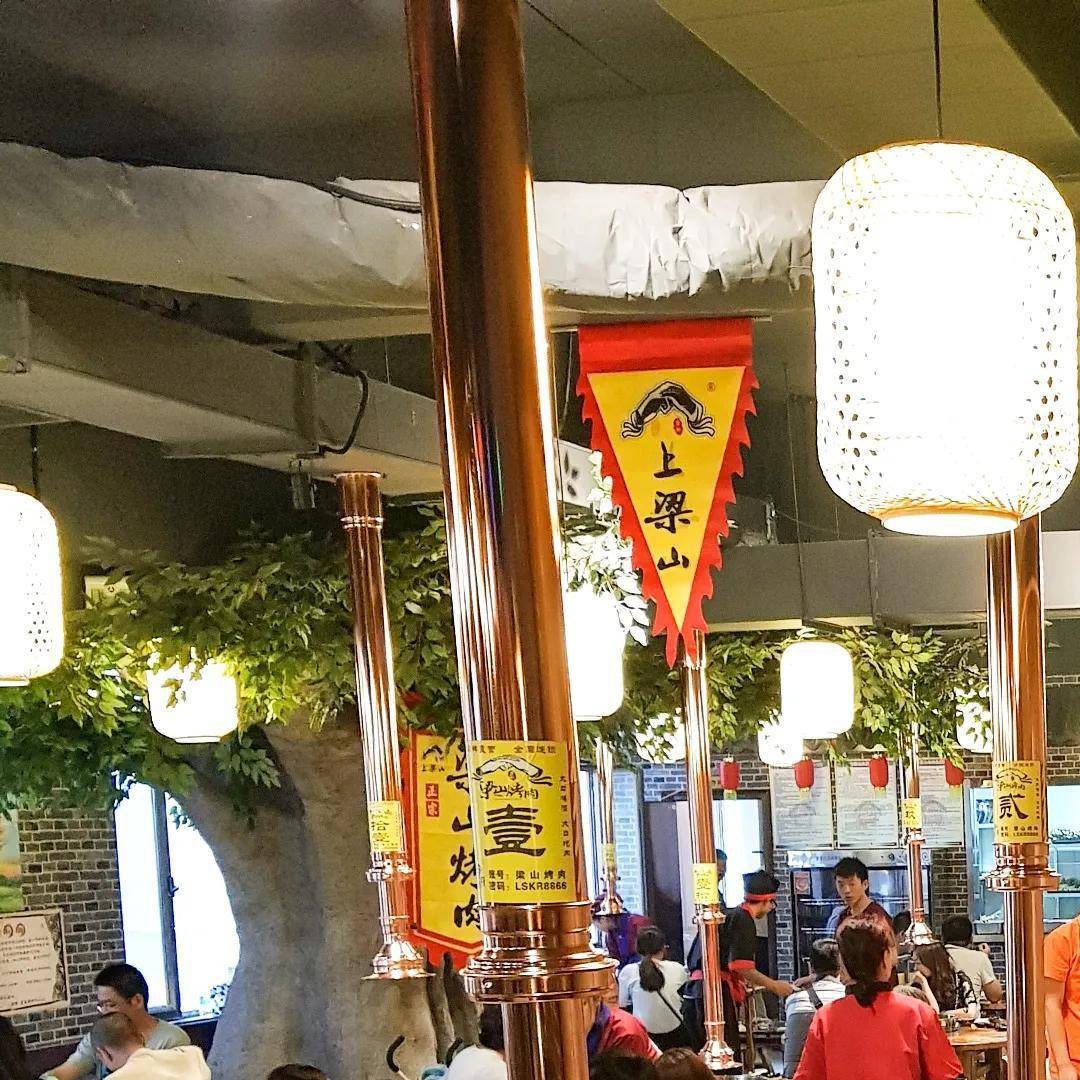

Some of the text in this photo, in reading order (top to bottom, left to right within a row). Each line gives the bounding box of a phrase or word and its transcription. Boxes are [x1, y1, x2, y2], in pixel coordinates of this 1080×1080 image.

[644, 441, 693, 571] 上梁山
[483, 803, 546, 857] 壹
